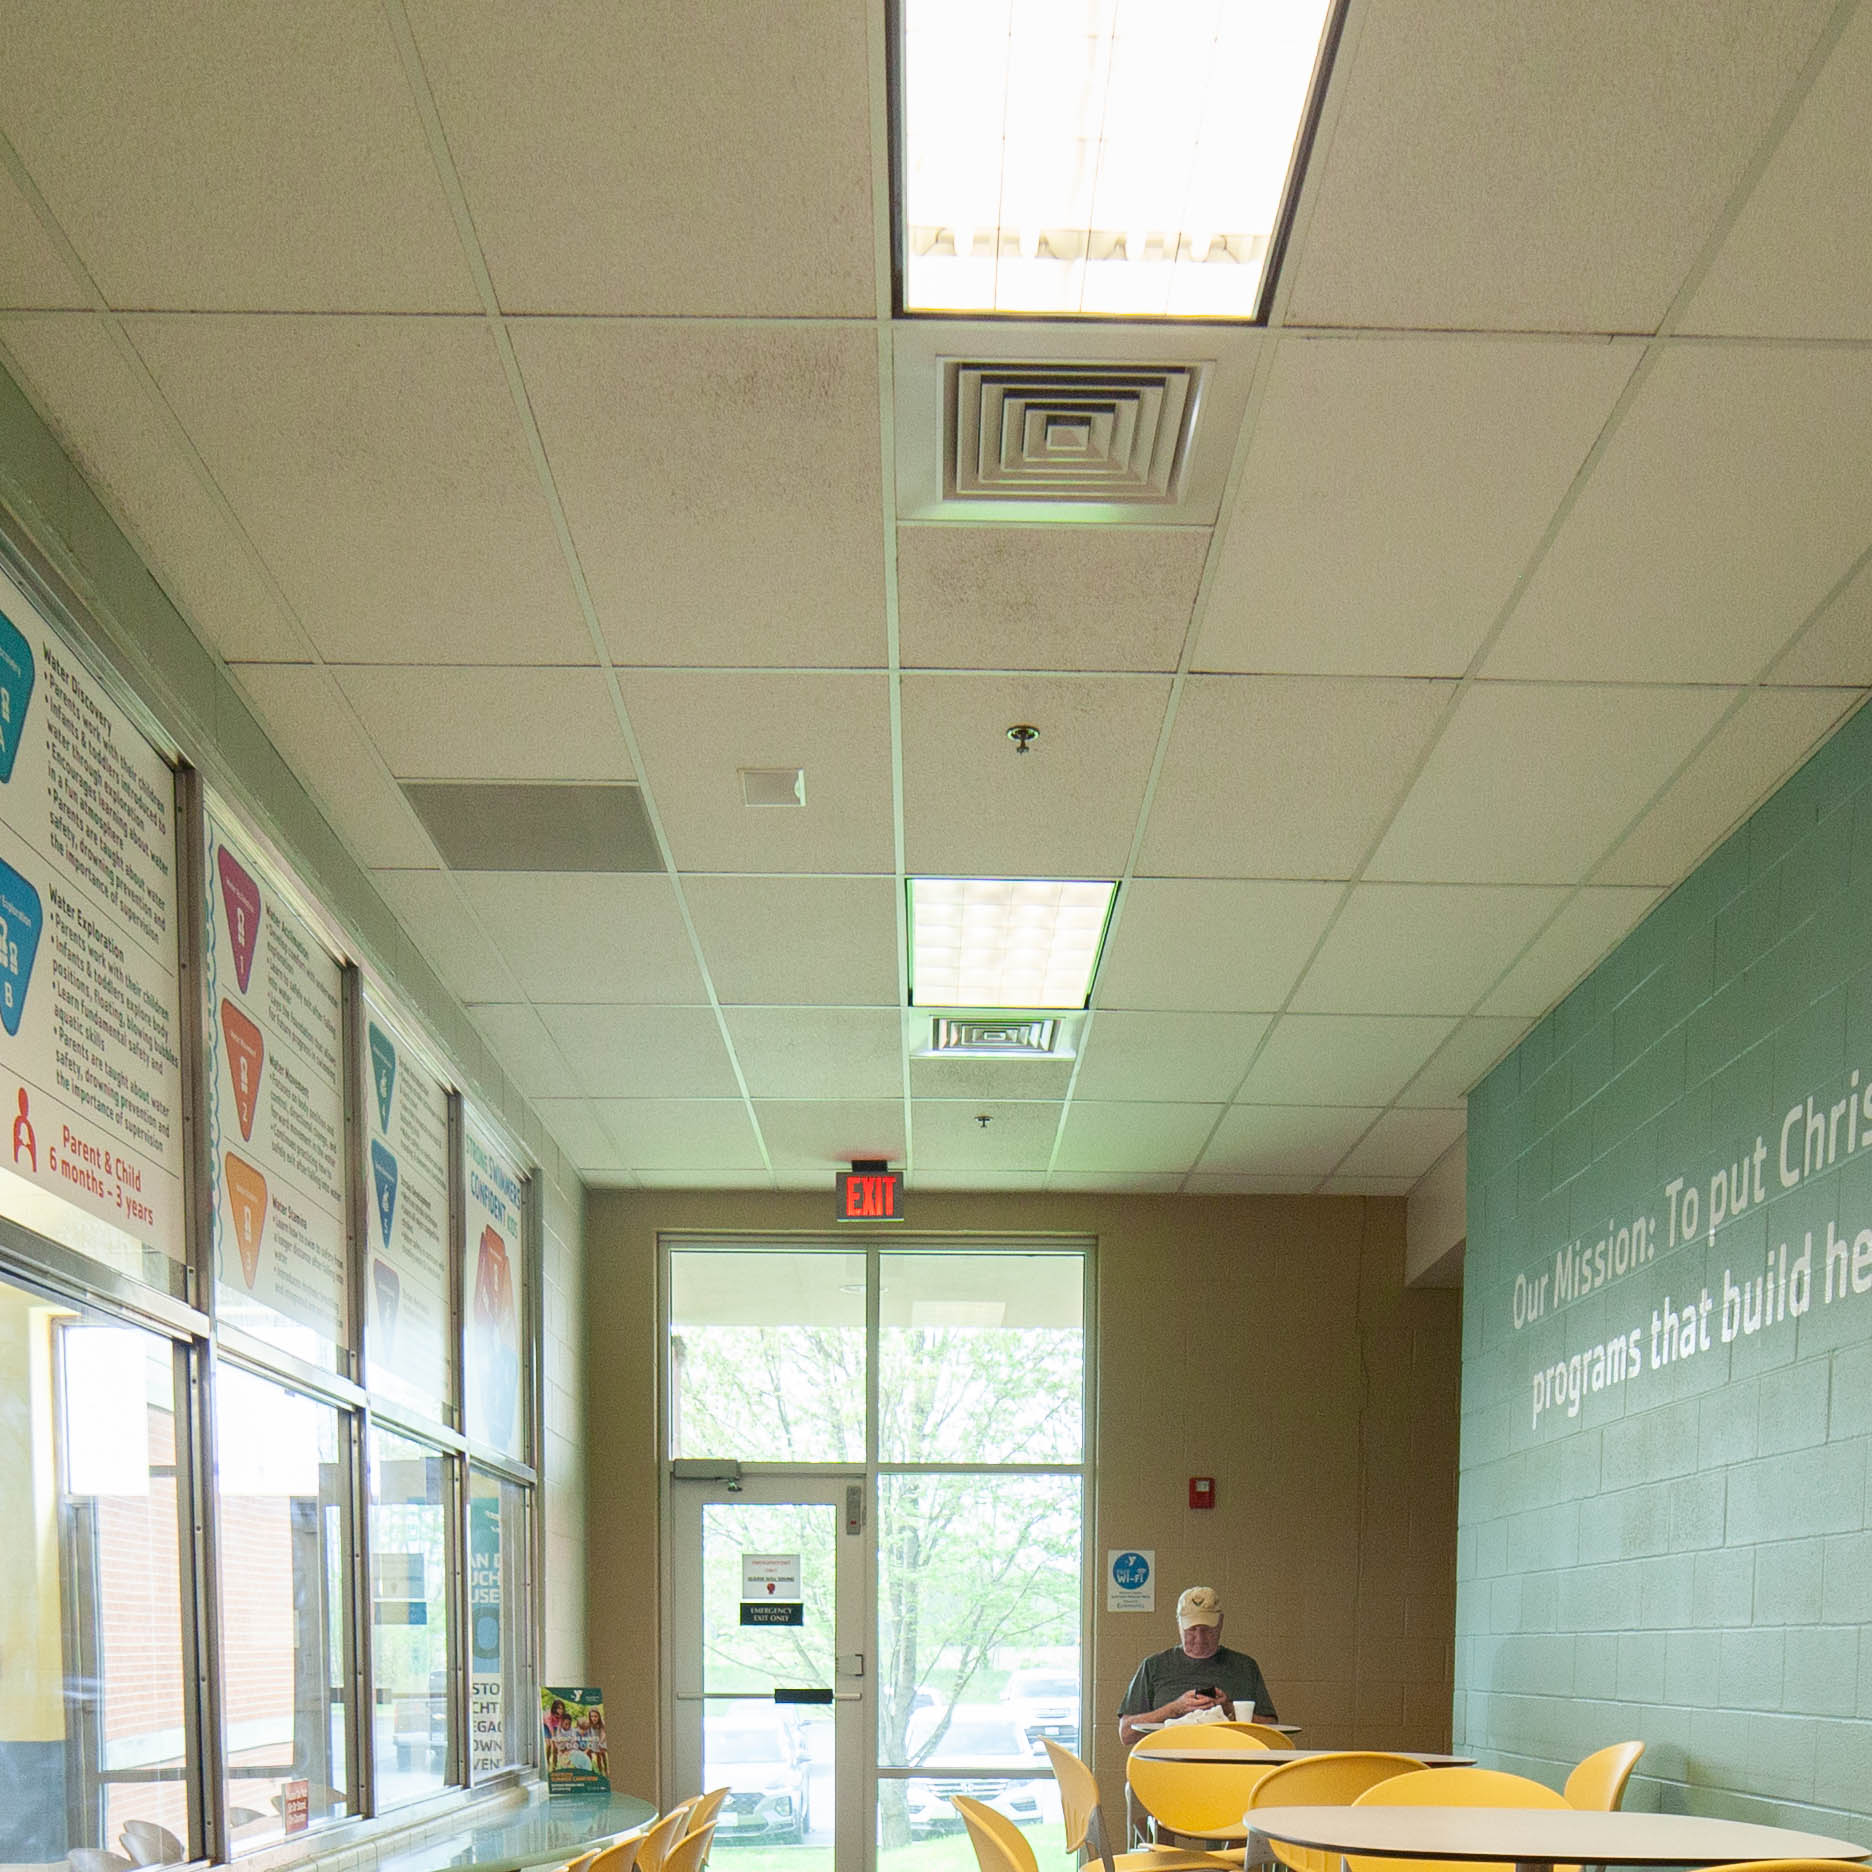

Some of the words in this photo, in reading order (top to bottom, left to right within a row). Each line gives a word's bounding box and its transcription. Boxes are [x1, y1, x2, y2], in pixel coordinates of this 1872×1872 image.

[41, 640, 69, 685] Water
[70, 674, 112, 738] Discovery
[48, 882, 75, 920] Water
[76, 907, 124, 963] Exploration
[4, 980, 14, 1009] B
[49, 1146, 57, 1171] 6
[61, 1159, 104, 1199] months
[116, 1184, 123, 1208] 3
[125, 1196, 154, 1226] years
[63, 1123, 101, 1170] Parent
[104, 1151, 112, 1175] &
[115, 1157, 142, 1193] Child
[846, 1176, 897, 1217] EXIT
[1512, 1271, 1549, 1331] Our
[1554, 1214, 1656, 1308] Mission:
[1664, 1179, 1699, 1249] To
[1707, 1136, 1767, 1246] put
[1531, 1324, 1642, 1430] programs
[1650, 1296, 1713, 1373] that
[1721, 1232, 1812, 1345] build
[753, 1614, 769, 1622] EXIT
[769, 1614, 790, 1623] ONLY
